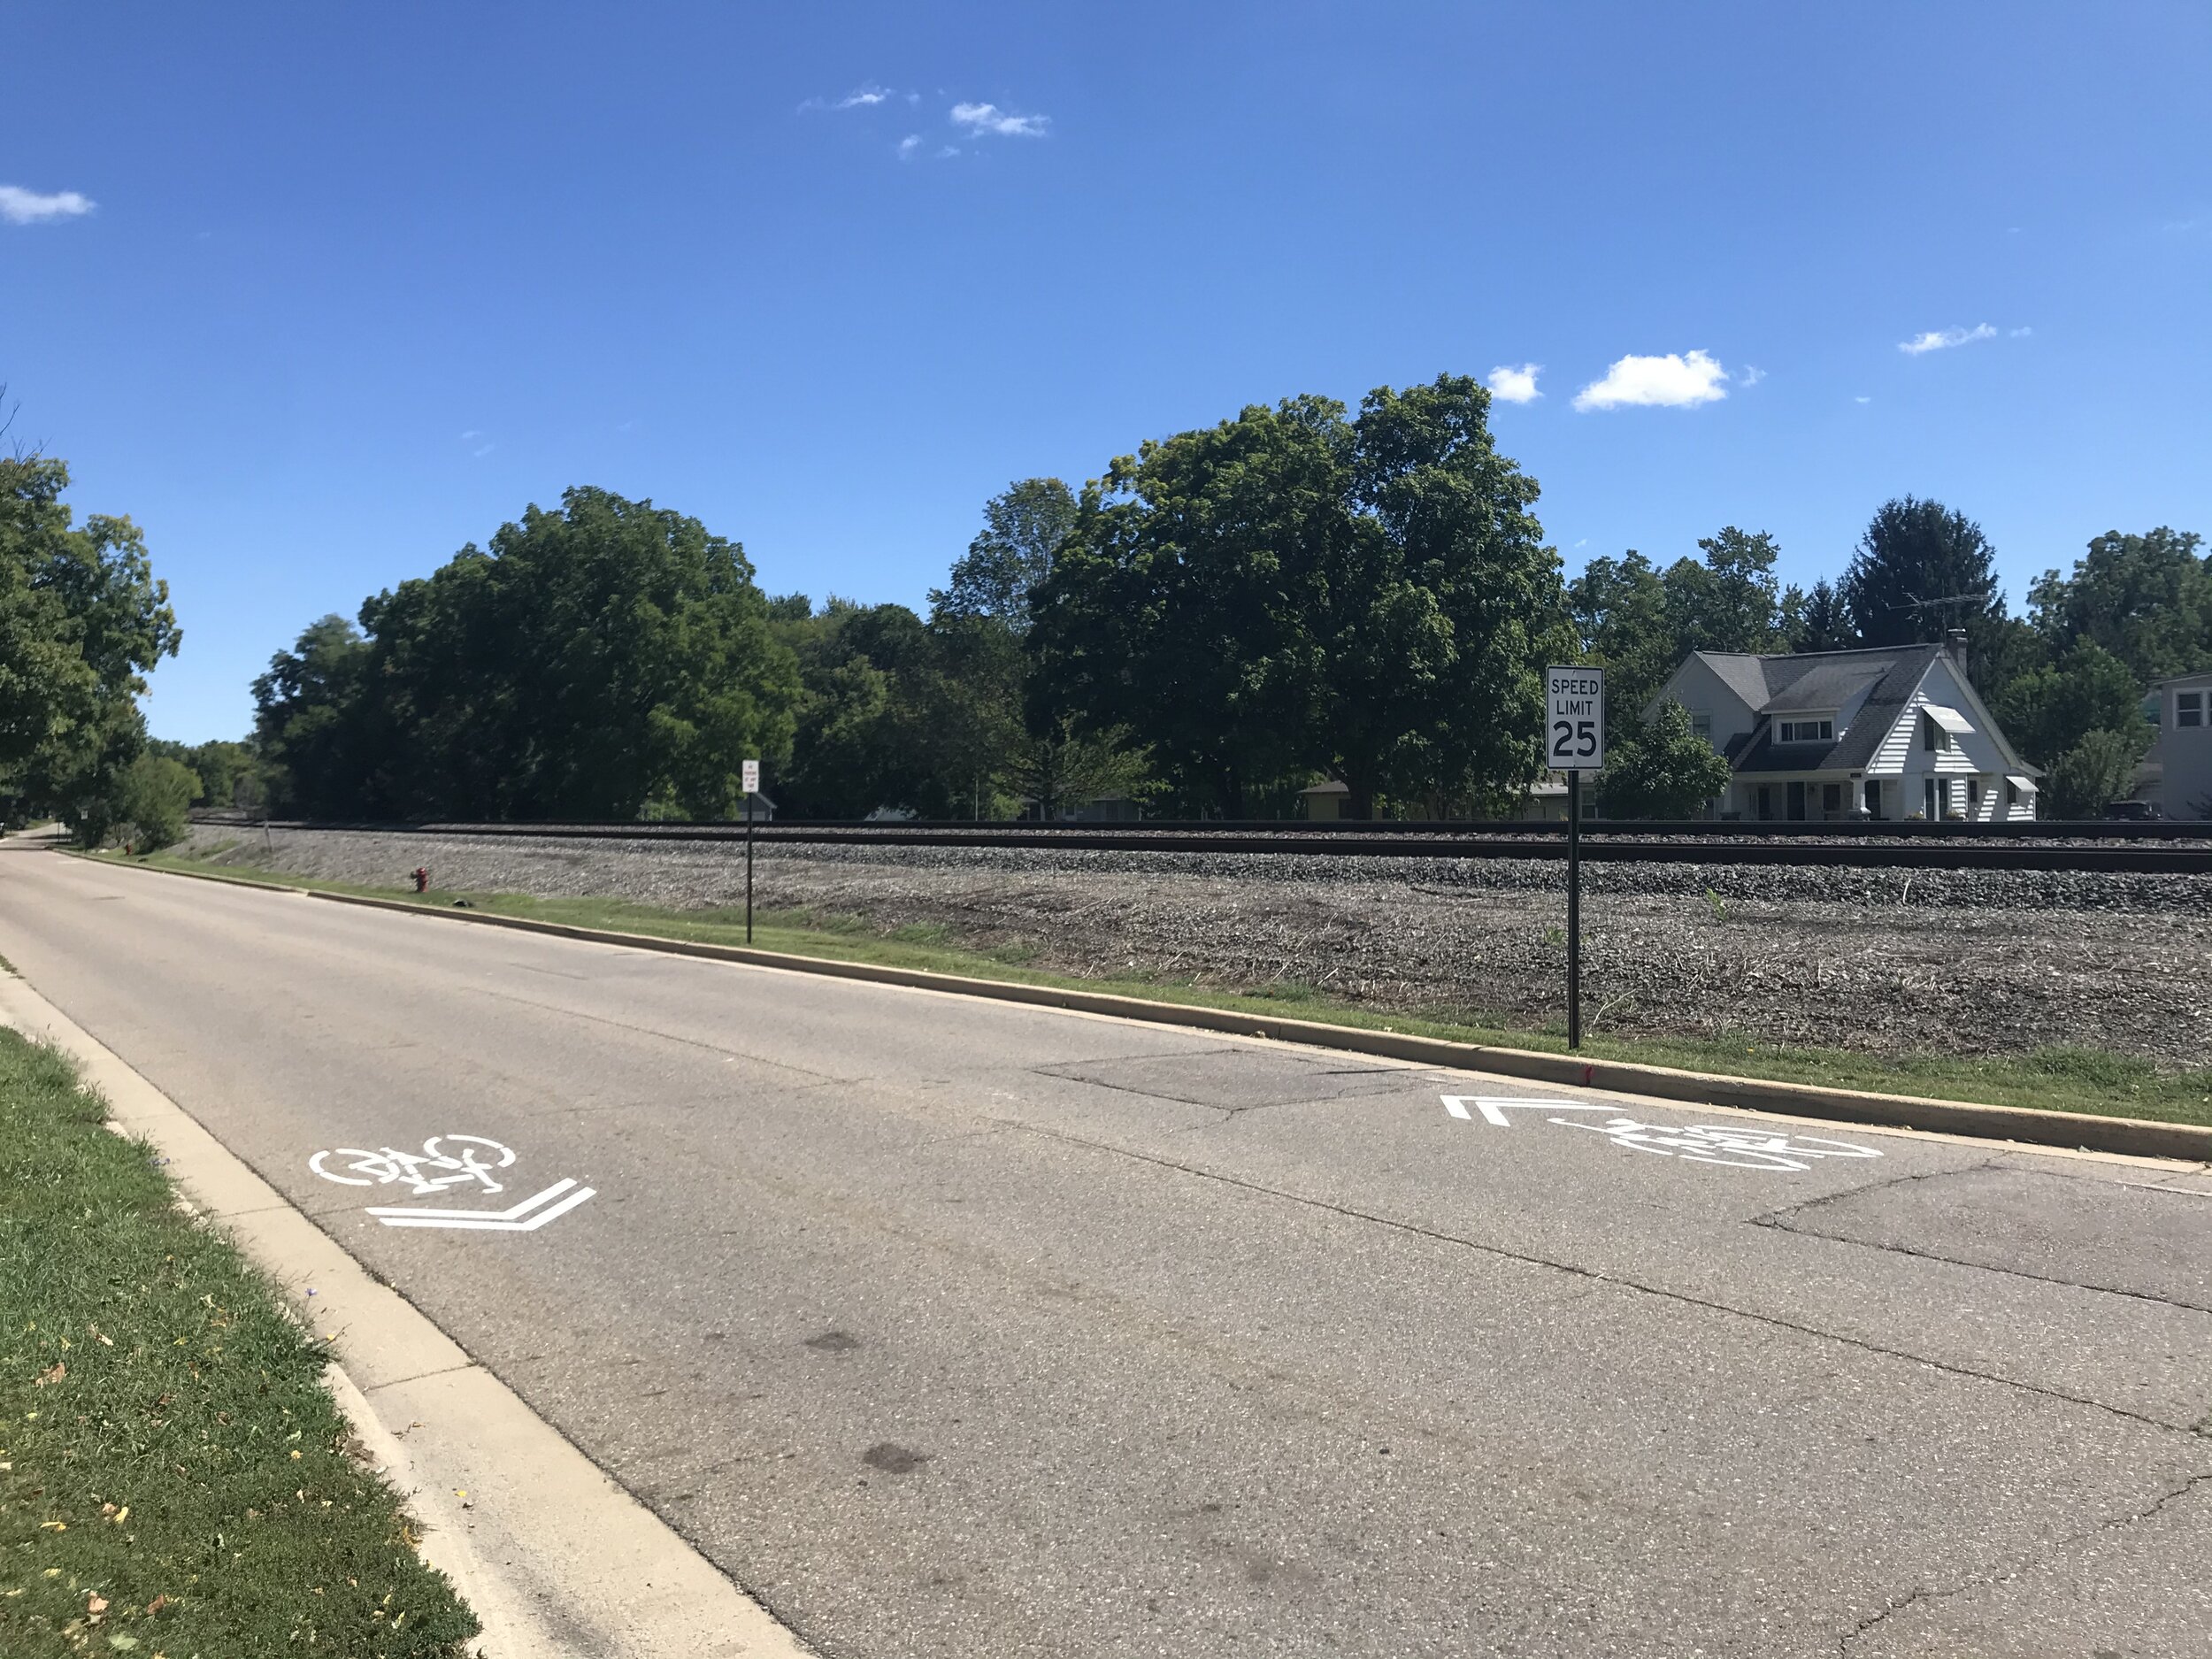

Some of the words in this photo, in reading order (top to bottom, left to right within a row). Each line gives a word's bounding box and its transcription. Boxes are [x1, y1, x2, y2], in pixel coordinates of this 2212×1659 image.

[1551, 679, 1599, 695] SPEED
[1556, 700, 1594, 716] LIMIT
[1553, 720, 1597, 757] 25
